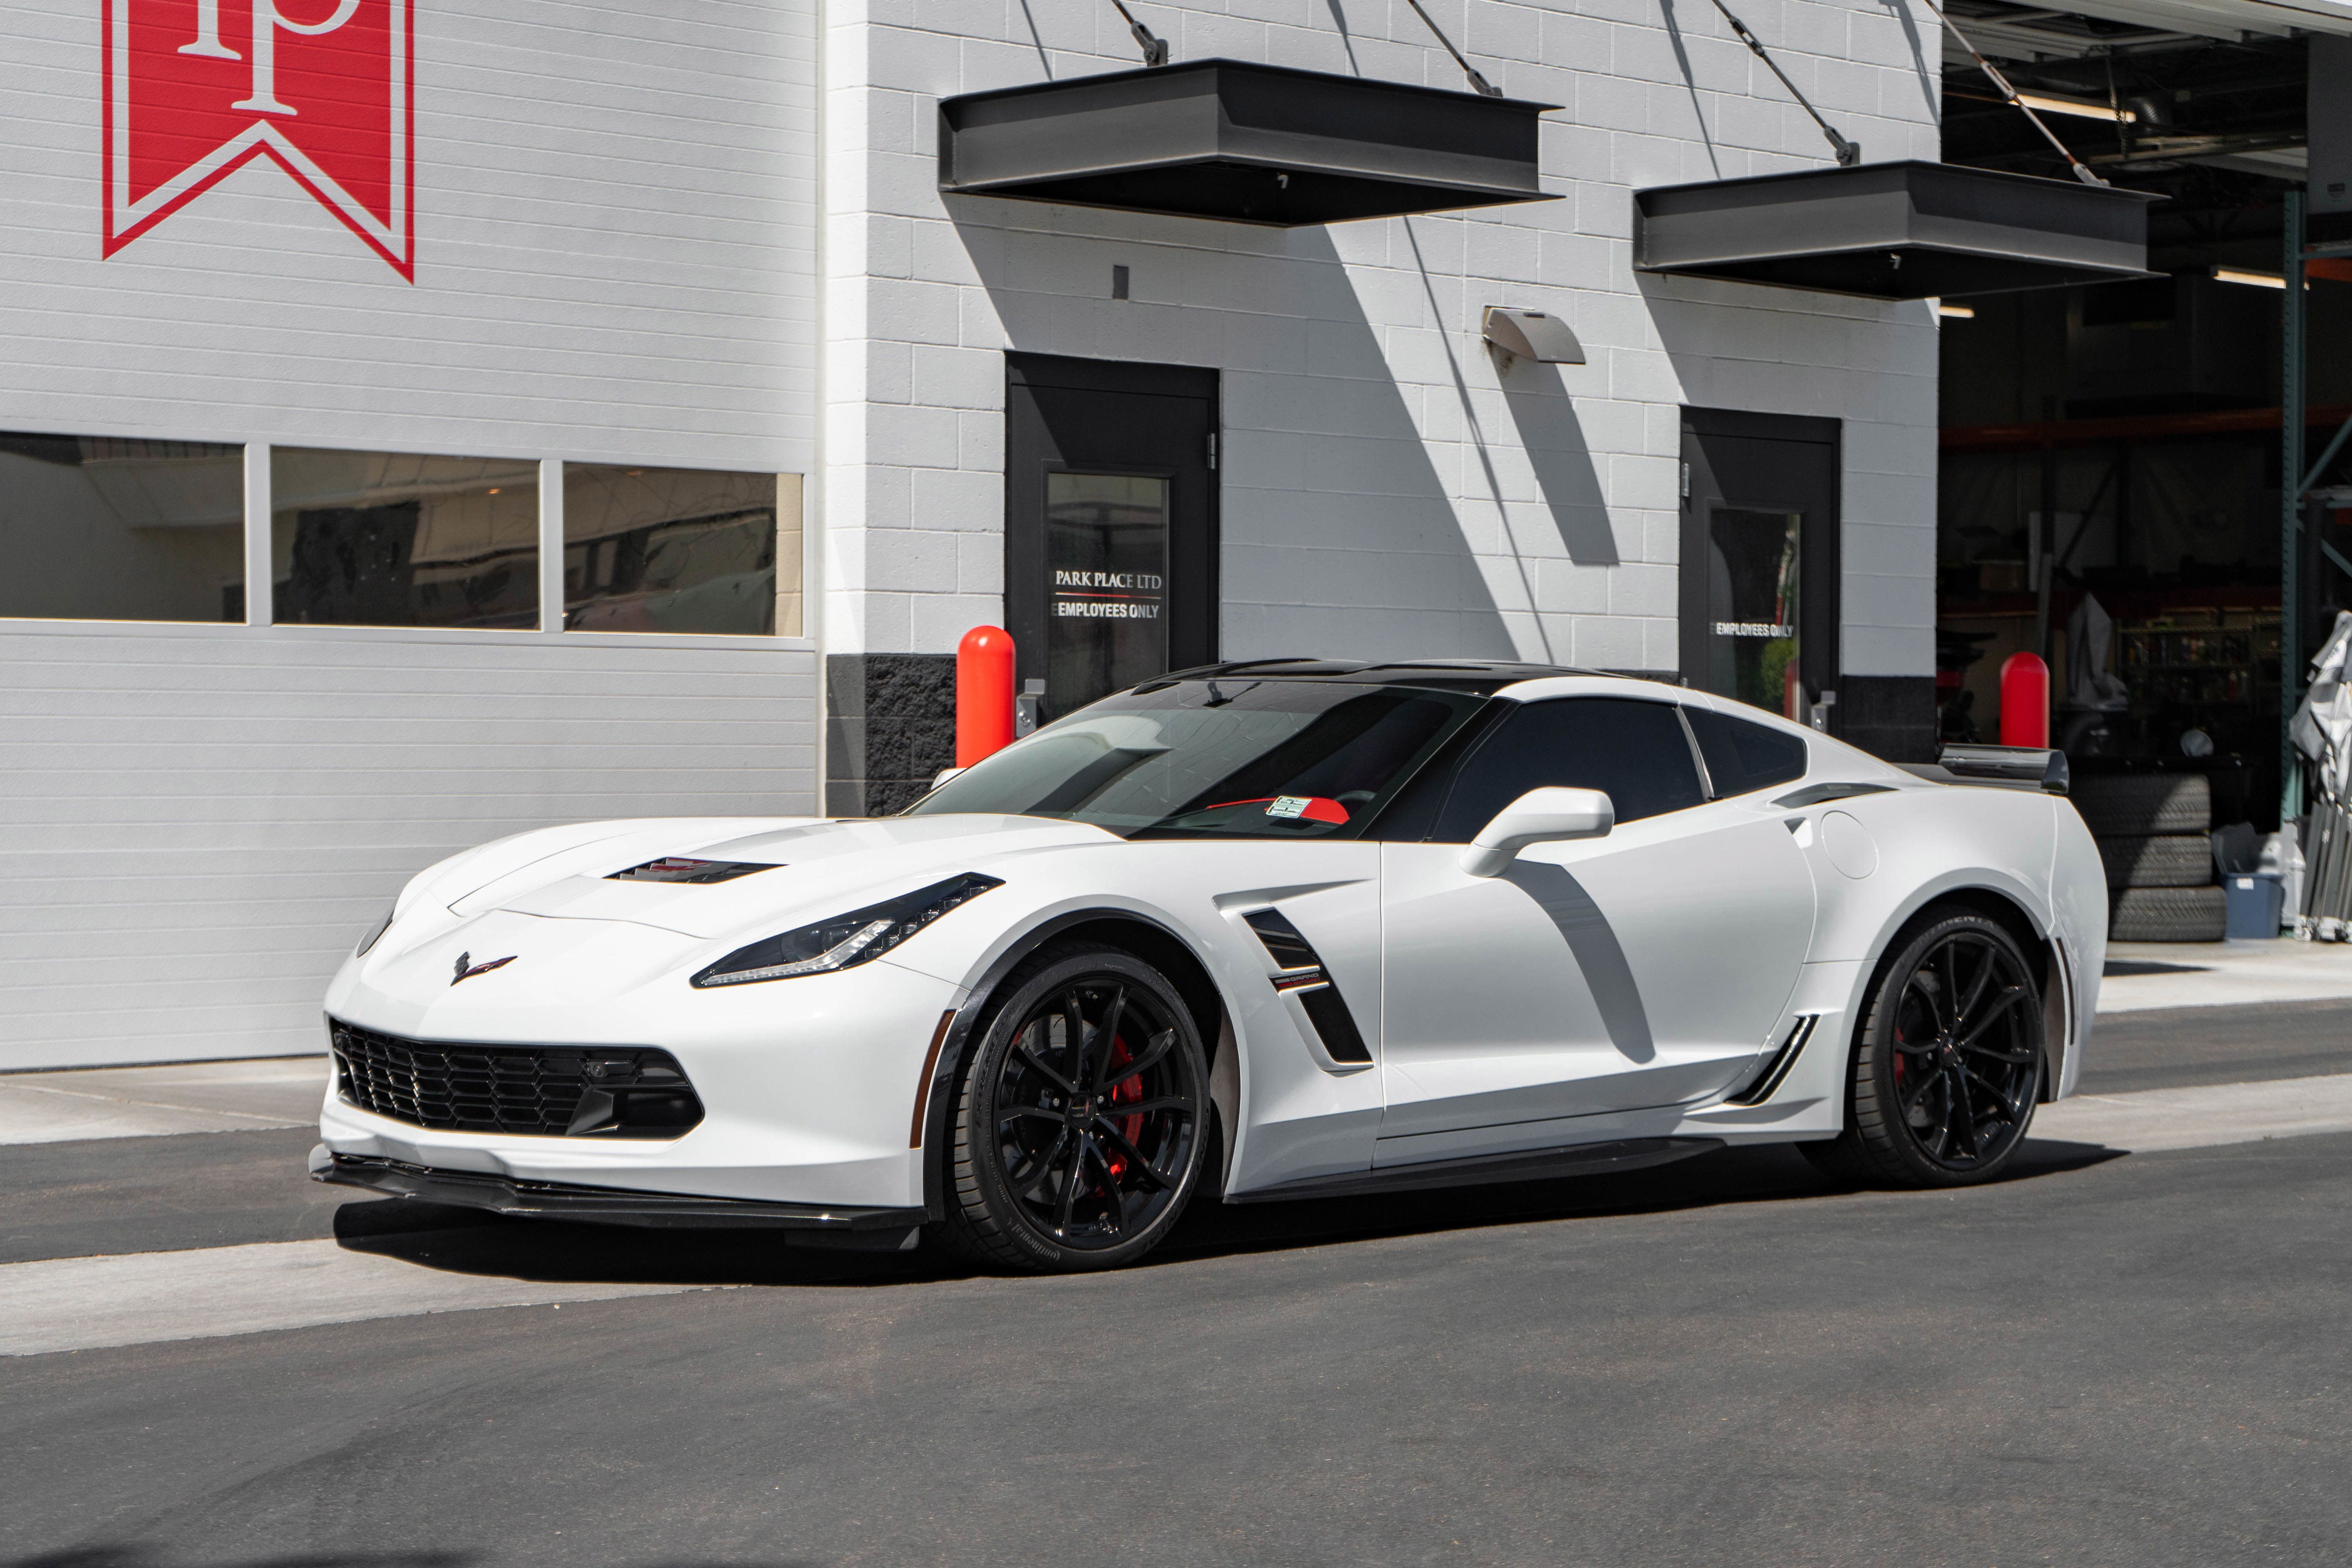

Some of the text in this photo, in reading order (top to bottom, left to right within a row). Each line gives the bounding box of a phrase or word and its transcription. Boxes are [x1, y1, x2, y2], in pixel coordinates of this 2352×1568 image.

[1056, 570, 1162, 589] PARK PLACE LTD
[1058, 601, 1159, 619] EMPLOYEES ONLY
[1717, 622, 1793, 638] EMPLOYEES ONLY
[1290, 973, 1319, 982] GRAND
[1011, 1223, 1060, 1261] Continental
